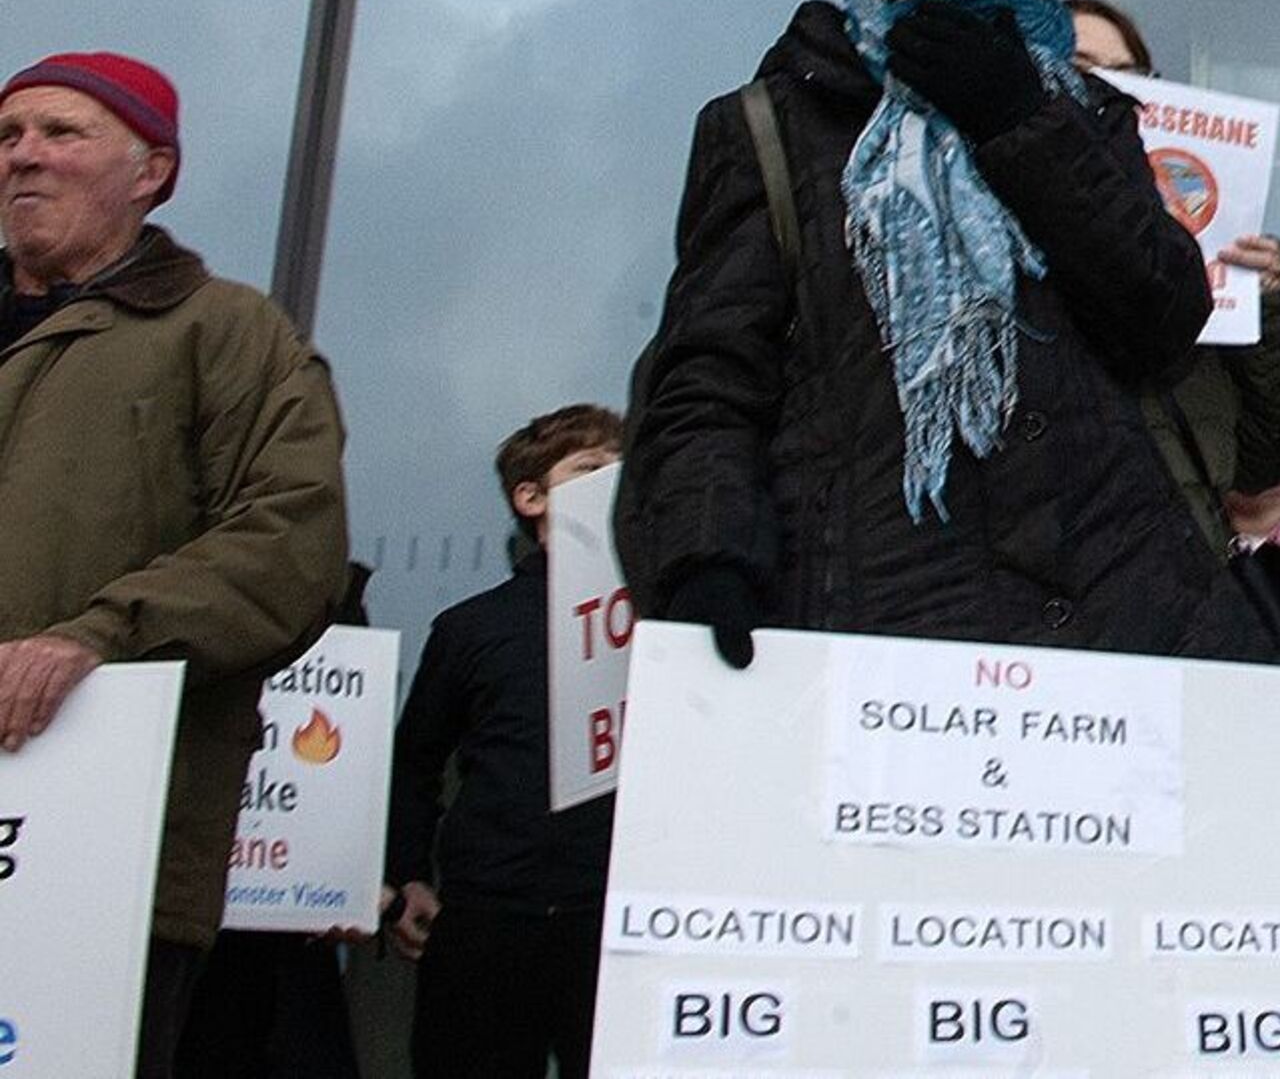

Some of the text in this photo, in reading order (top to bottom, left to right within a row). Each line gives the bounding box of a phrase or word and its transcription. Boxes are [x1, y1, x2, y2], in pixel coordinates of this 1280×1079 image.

[976, 660, 1032, 690] NO
[861, 701, 1126, 744] SOLAR FARM
[982, 759, 1006, 786] &
[836, 803, 1130, 844] BESS STATION
[621, 906, 853, 944] LOCATION
[892, 916, 1104, 948] LOCATION
[674, 993, 781, 1038] BIG
[930, 1000, 1028, 1042] BIG
